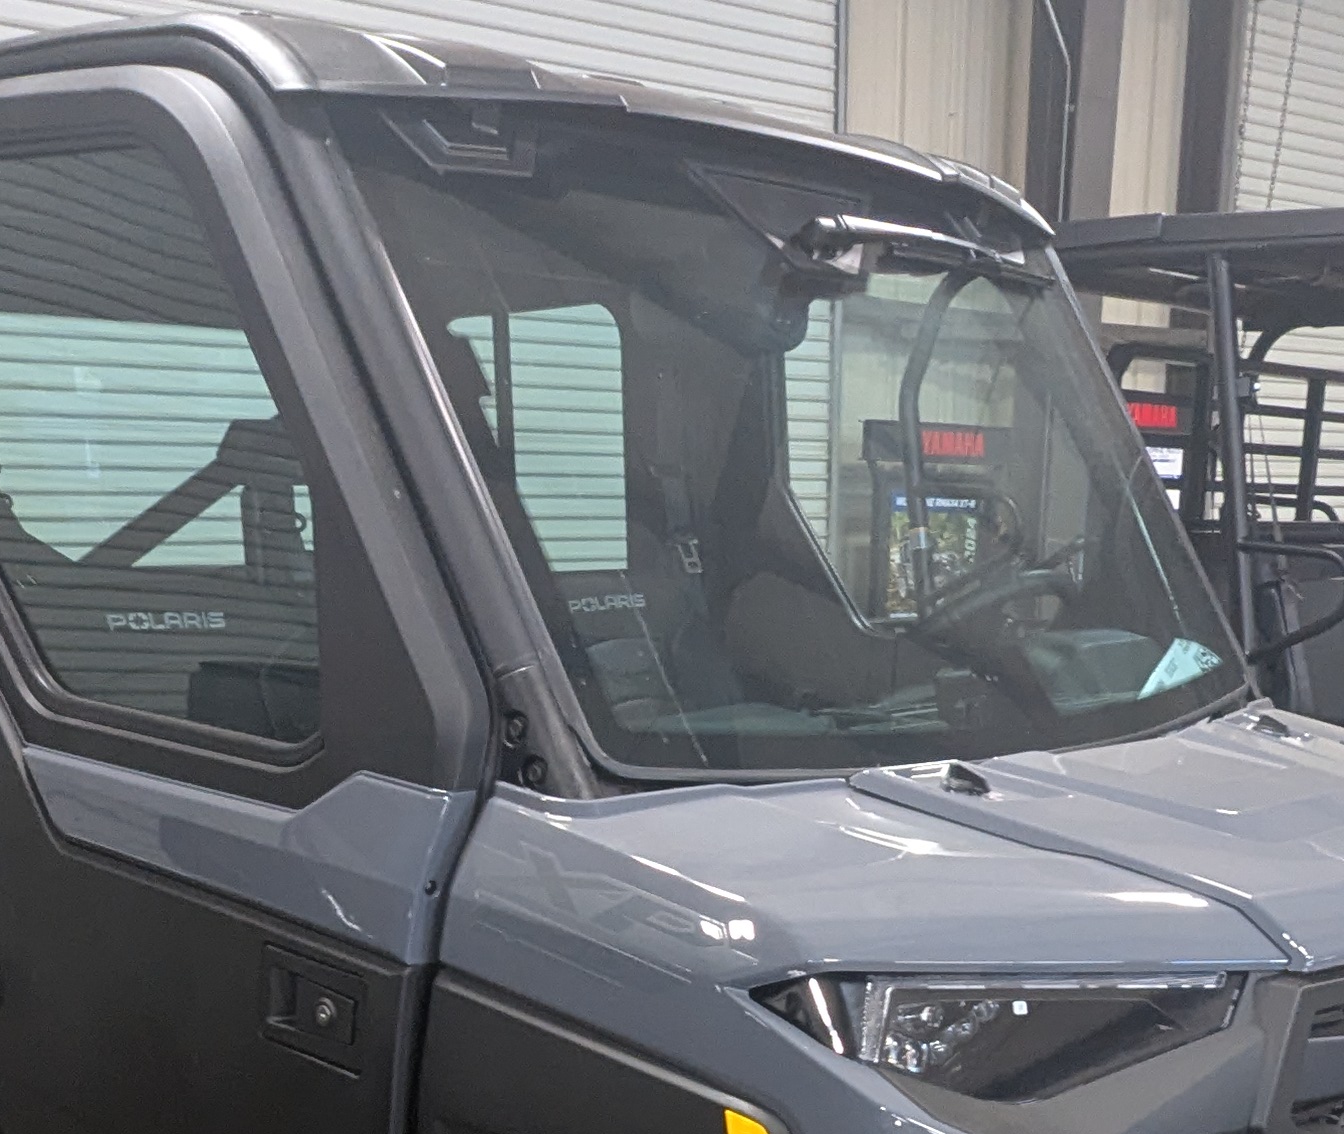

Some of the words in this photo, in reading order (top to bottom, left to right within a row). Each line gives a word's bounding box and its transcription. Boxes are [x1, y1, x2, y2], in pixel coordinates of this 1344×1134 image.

[922, 430, 984, 457] YAMAHA
[568, 593, 646, 613] POLARIS
[106, 611, 226, 631] POLARIS
